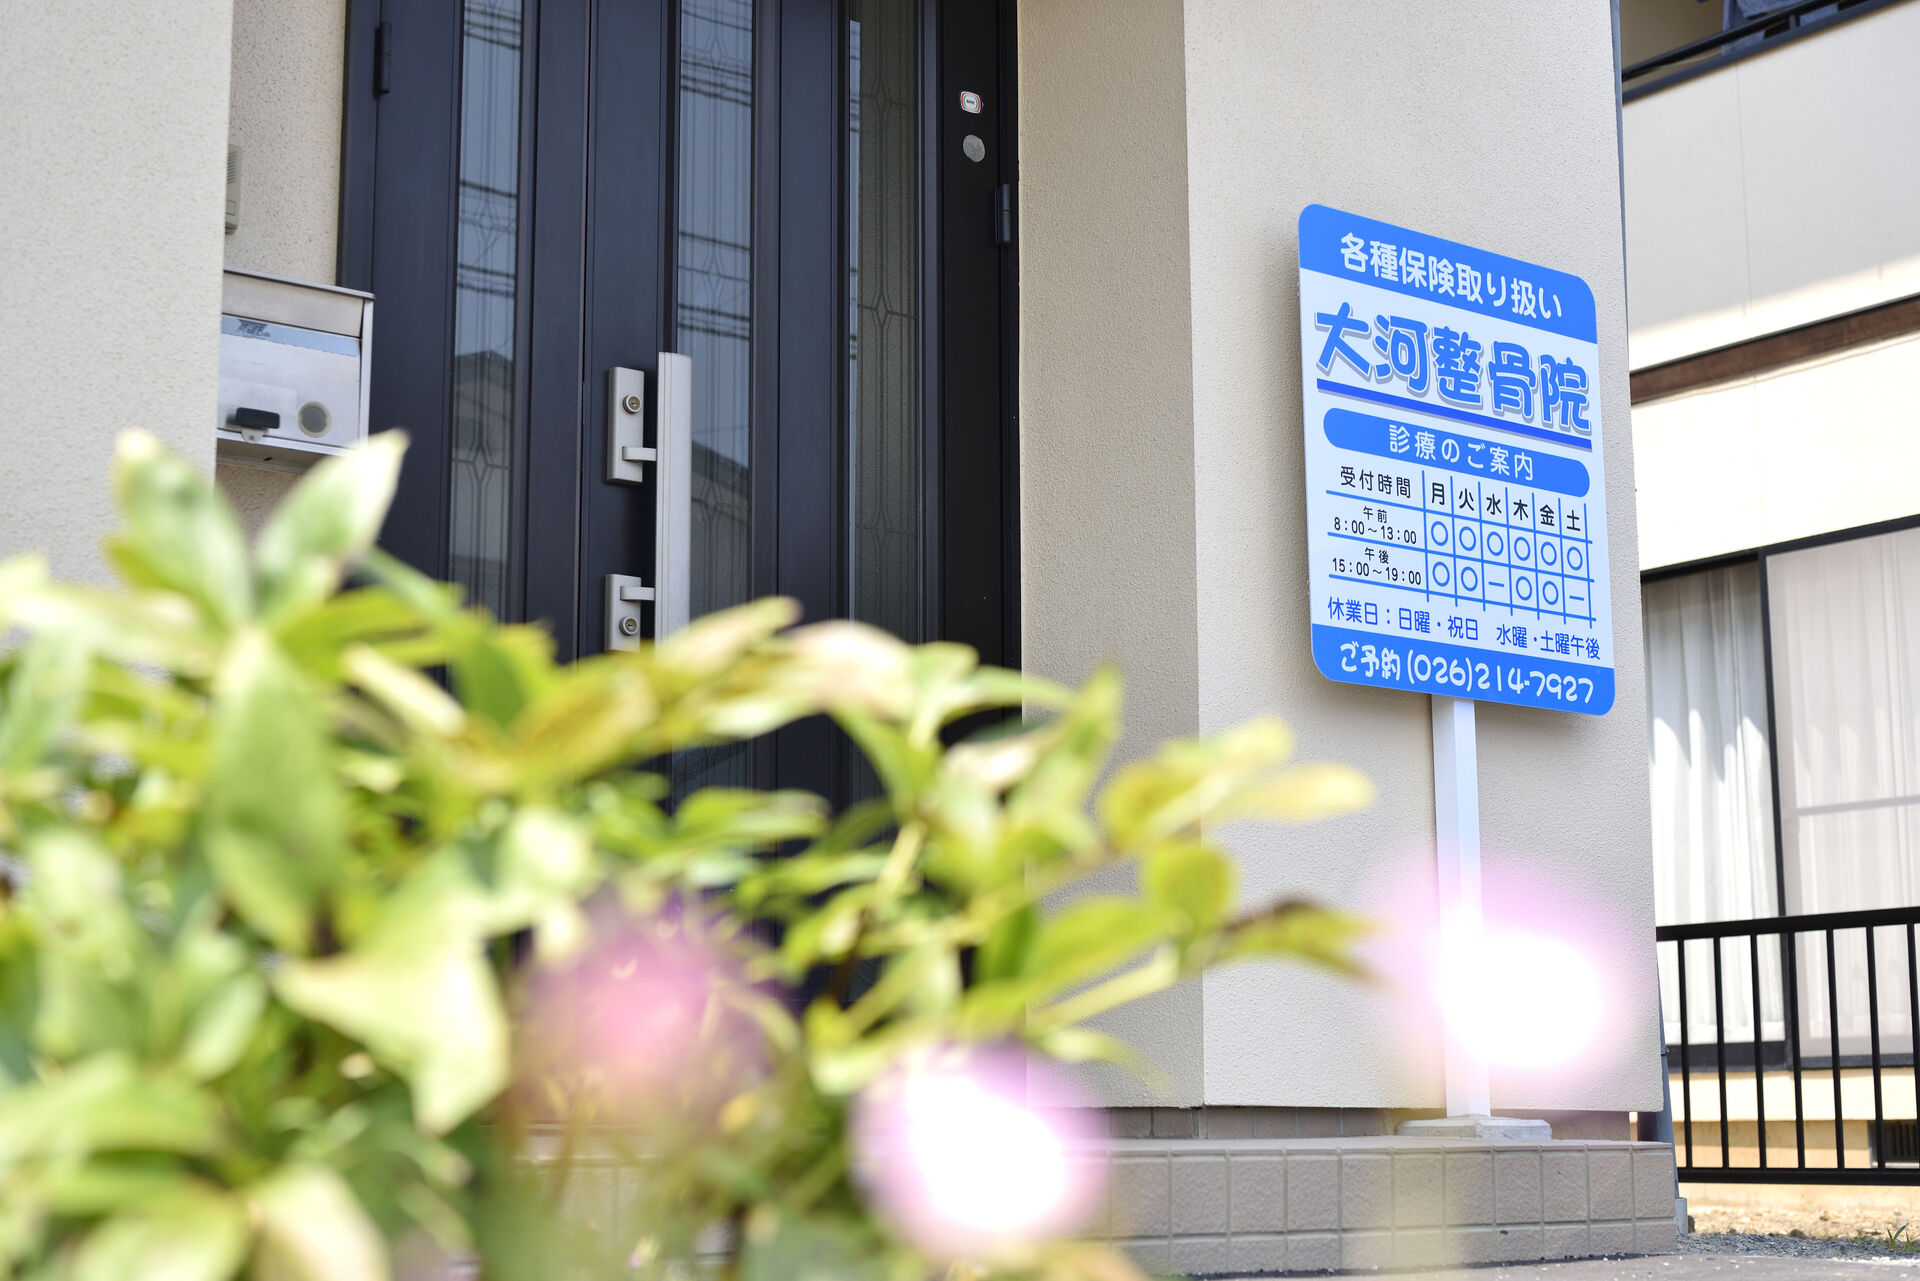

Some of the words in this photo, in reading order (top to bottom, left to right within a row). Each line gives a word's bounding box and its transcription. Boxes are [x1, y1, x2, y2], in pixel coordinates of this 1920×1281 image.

[1340, 232, 1562, 319] 各種保険取り扱い
[1315, 302, 1591, 431] 大河整骨院
[1389, 424, 1534, 481] 診療のご案内
[1340, 466, 1411, 498] 受付時間
[1431, 482, 1446, 506] 月
[1458, 488, 1475, 512] 火
[1486, 493, 1502, 516] 水
[1513, 498, 1529, 521] 木
[1539, 504, 1556, 527] 金
[1566, 510, 1581, 532] 土
[1363, 506, 1388, 523] 午前
[1364, 547, 1389, 564] 午後
